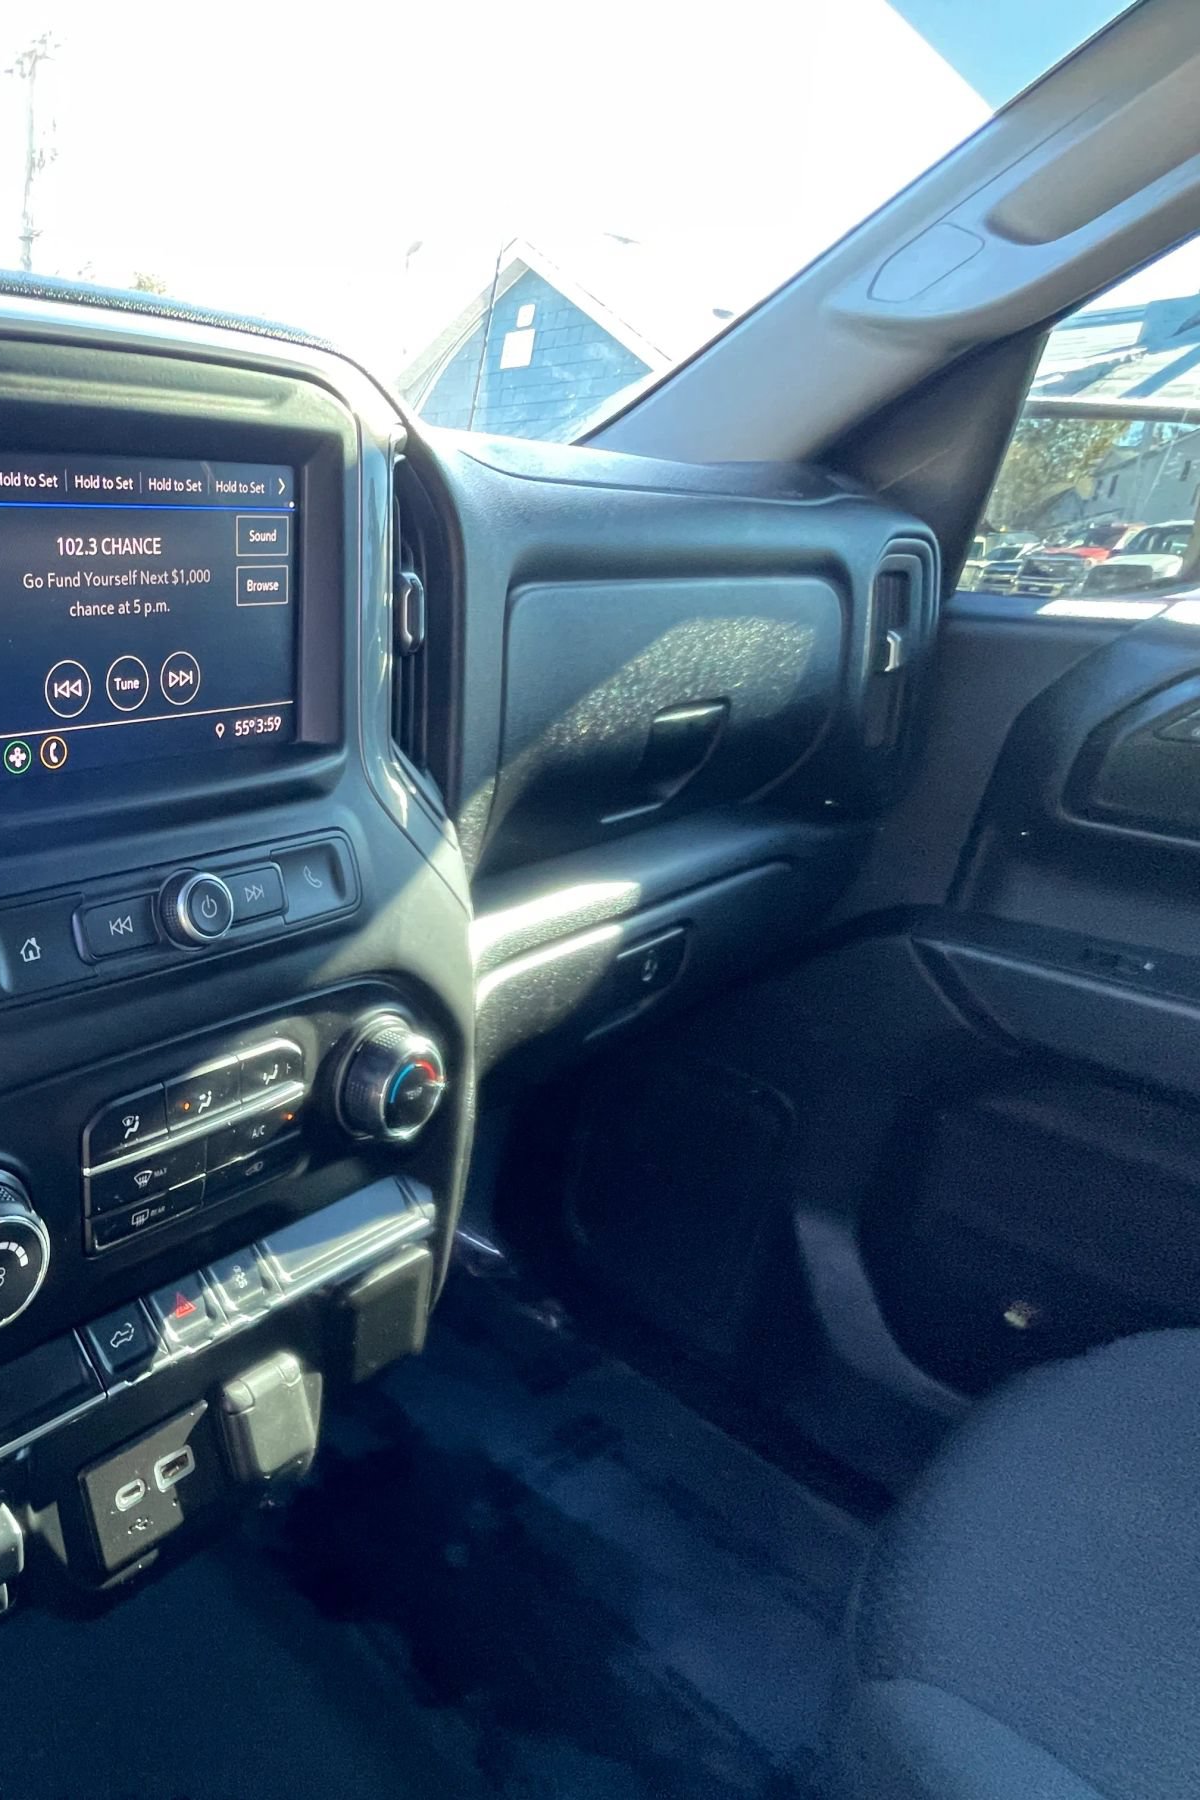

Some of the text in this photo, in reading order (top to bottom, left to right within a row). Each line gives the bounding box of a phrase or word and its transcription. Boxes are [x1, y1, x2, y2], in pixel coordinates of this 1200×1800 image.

[24, 475, 36, 488] to
[39, 473, 58, 488] Set
[75, 474, 134, 491] Hold to Set
[148, 477, 202, 492] Hold to Set
[216, 480, 265, 494] Hold to Set
[249, 529, 277, 543] Sound
[57, 536, 162, 556] 102.3 CHANCE
[23, 568, 211, 589] Go Fund Yourself Next $1,000
[246, 578, 279, 593] Browse
[69, 599, 170, 617] chance at 5 p.m.
[114, 677, 140, 691] Tune
[256, 716, 282, 734] 3:59
[252, 1125, 265, 1139] A/C
